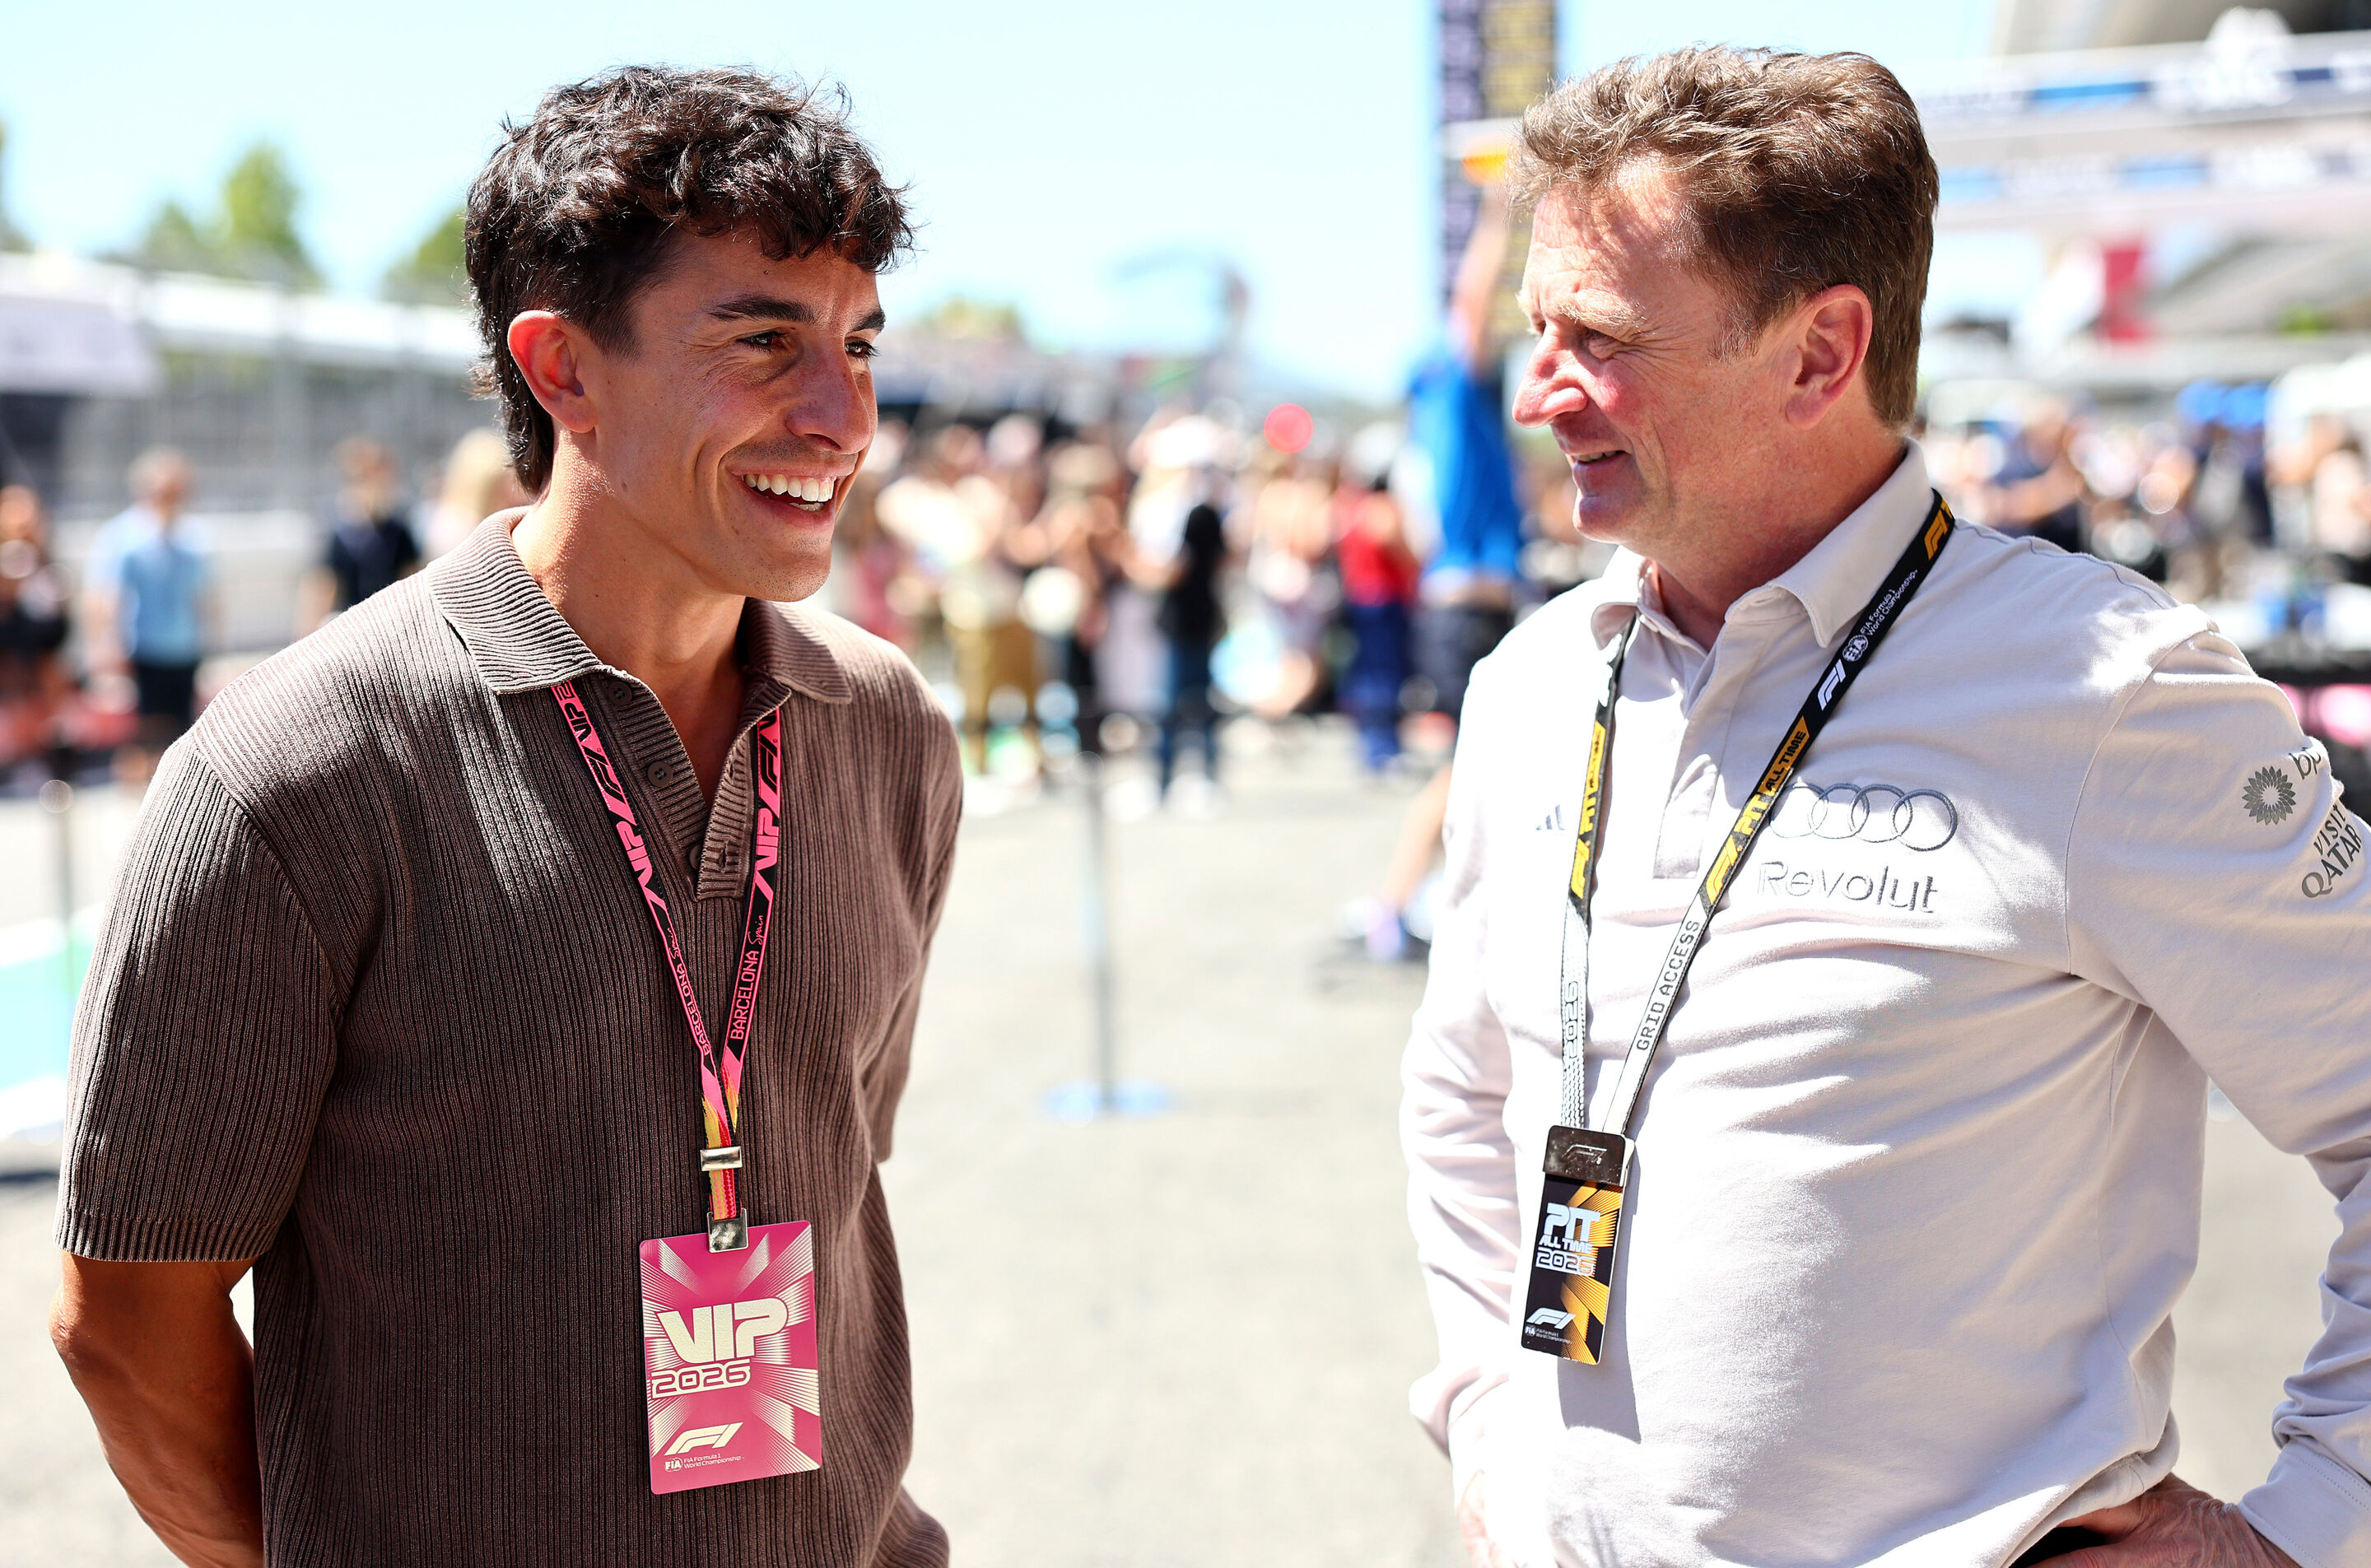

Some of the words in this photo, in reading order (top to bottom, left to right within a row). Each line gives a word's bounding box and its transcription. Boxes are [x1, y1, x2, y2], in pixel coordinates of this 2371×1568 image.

[1867, 615, 1884, 635] World
[1882, 571, 1916, 615] Championship
[1868, 593, 1892, 621] Formula
[1818, 658, 1846, 711] F1
[564, 703, 593, 742] VIP
[581, 745, 627, 804] F1
[759, 733, 778, 794] F1
[1766, 767, 1785, 791] ALL
[1778, 731, 1806, 765] TIME
[616, 821, 653, 887] VIP
[755, 807, 780, 871] VIP
[1706, 835, 1738, 905] F1
[1734, 793, 1770, 835] PIT
[2313, 804, 2346, 855] VISIT
[2302, 824, 2362, 897] QATAR
[1757, 861, 1938, 914] Revolut
[667, 927, 680, 959] Spain
[730, 950, 759, 1040] BARCELONA
[747, 915, 765, 945] Spain
[1637, 1002, 1665, 1050] GRID
[1659, 920, 1700, 996] ACCESS
[676, 963, 710, 1056] BARCELONA
[1539, 1235, 1561, 1249] ALL
[1562, 1238, 1593, 1254] TIME
[1544, 1203, 1600, 1242] PIT
[1535, 1247, 1595, 1276] 2026
[656, 1297, 788, 1364] VIP
[1526, 1307, 1576, 1330] F1
[653, 1360, 750, 1397] 2026
[664, 1422, 743, 1455] F1
[701, 1456, 742, 1466] Championship
